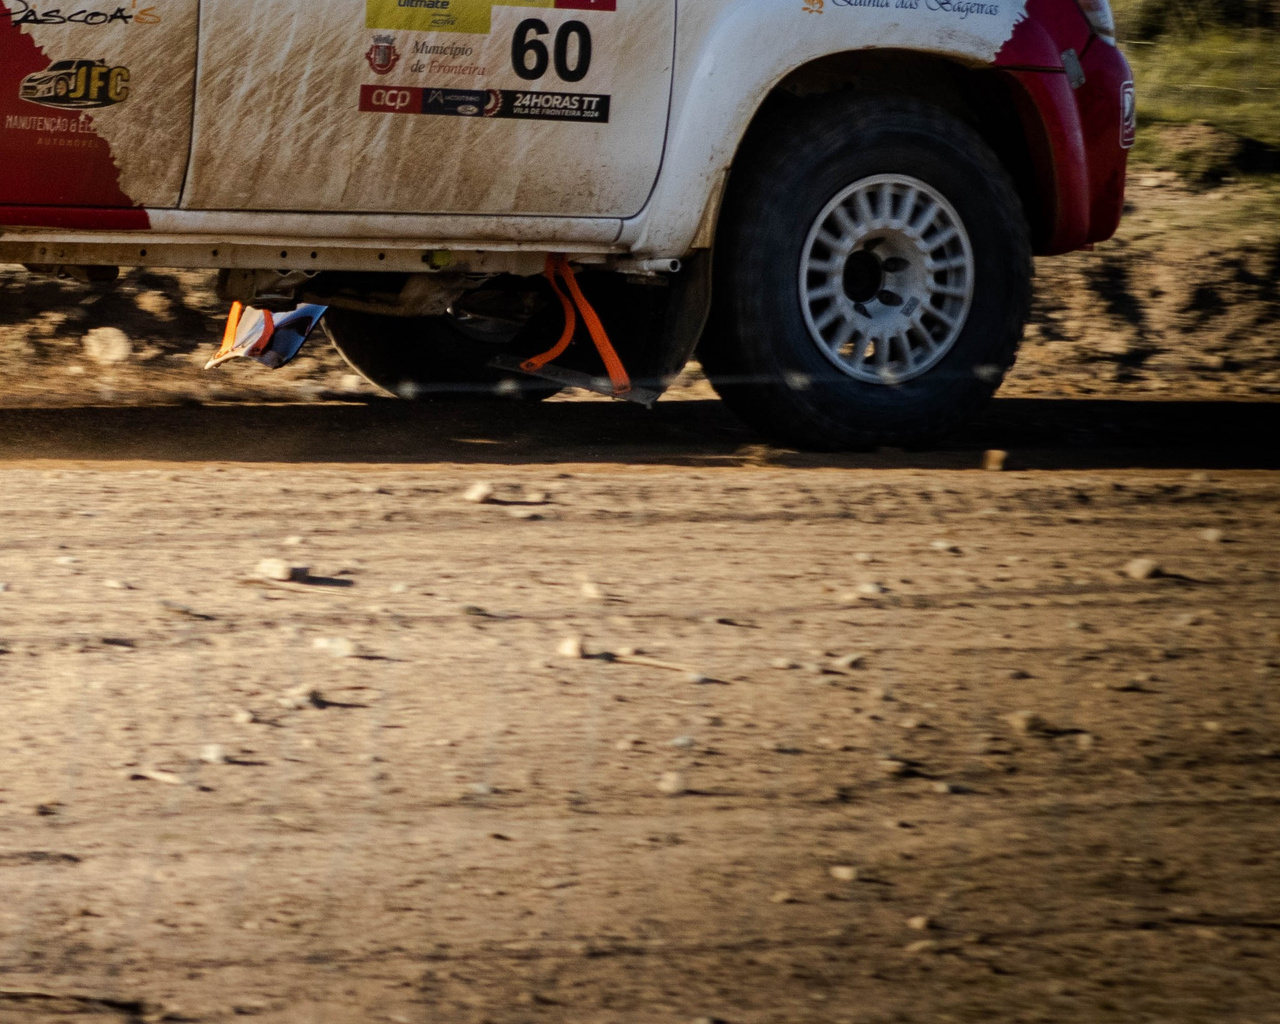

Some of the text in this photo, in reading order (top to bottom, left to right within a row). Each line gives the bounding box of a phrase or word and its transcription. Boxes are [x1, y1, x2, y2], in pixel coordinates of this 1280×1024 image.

[412, 40, 473, 58] Município
[511, 18, 592, 82] 60
[411, 60, 486, 76] de Fronteira
[69, 65, 131, 102] JFC
[372, 89, 410, 109] acp
[582, 96, 600, 110] TT
[541, 108, 580, 116] FRONTEIRA
